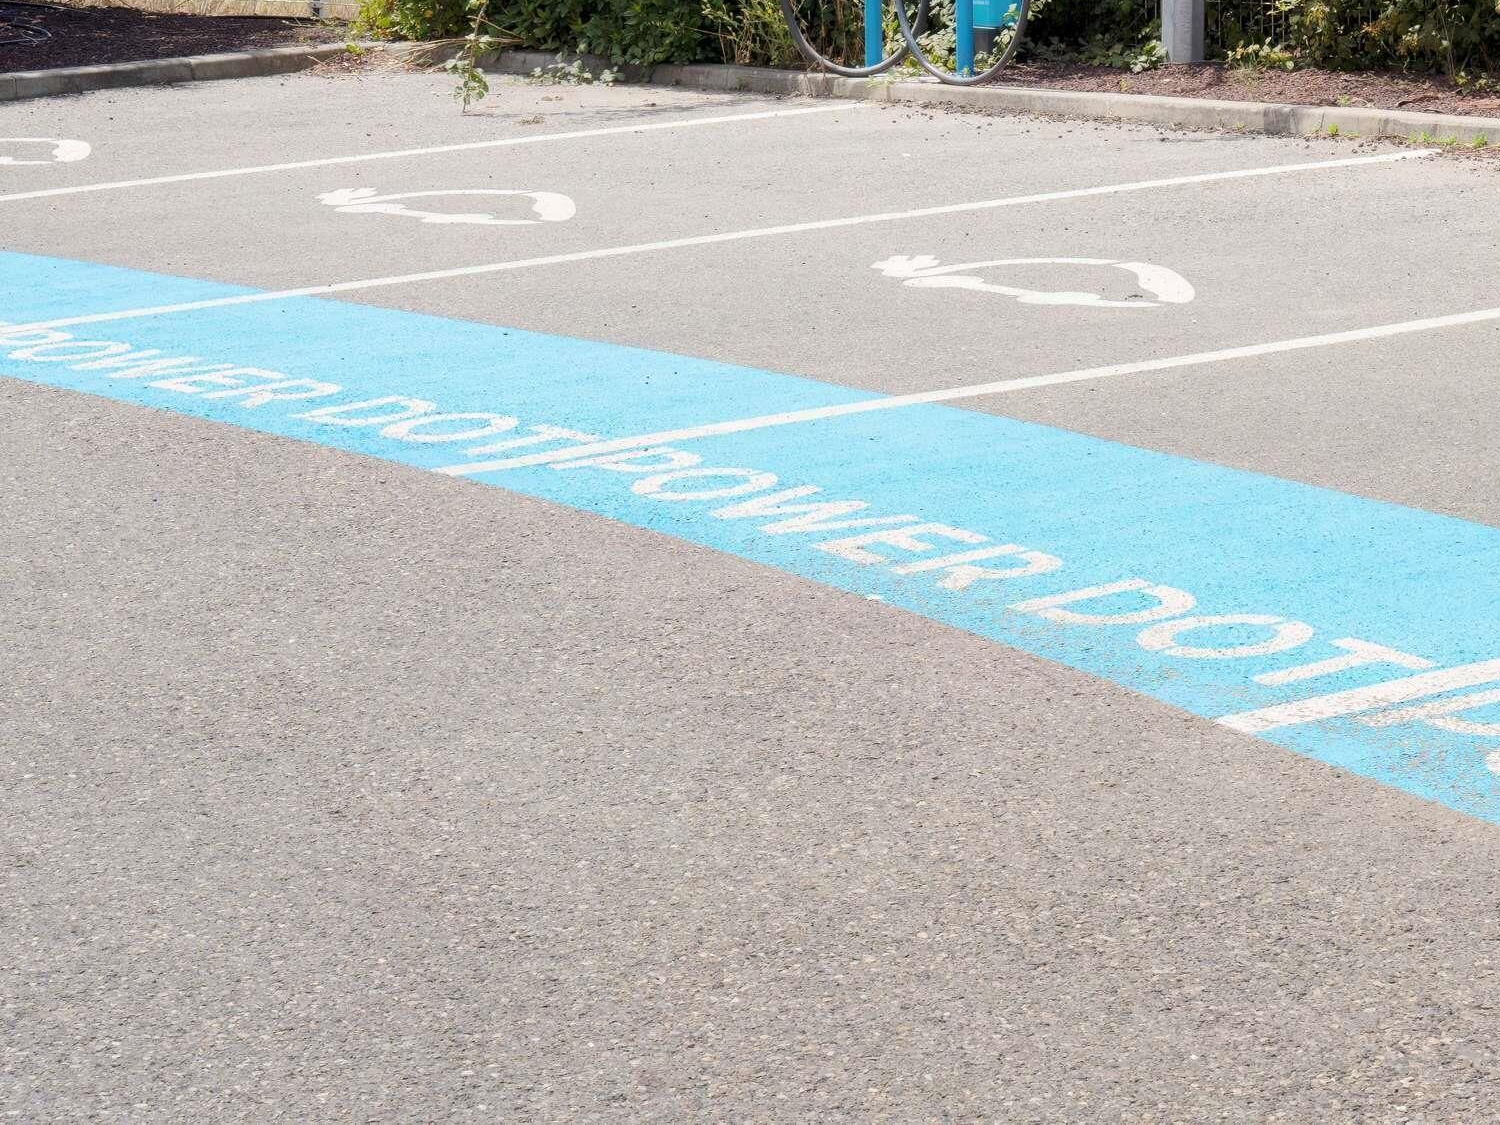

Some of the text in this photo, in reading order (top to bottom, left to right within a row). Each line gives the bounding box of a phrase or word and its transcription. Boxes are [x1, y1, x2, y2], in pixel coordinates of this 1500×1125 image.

[286, 394, 603, 456] DOT
[550, 446, 1439, 686] POWER DOT
